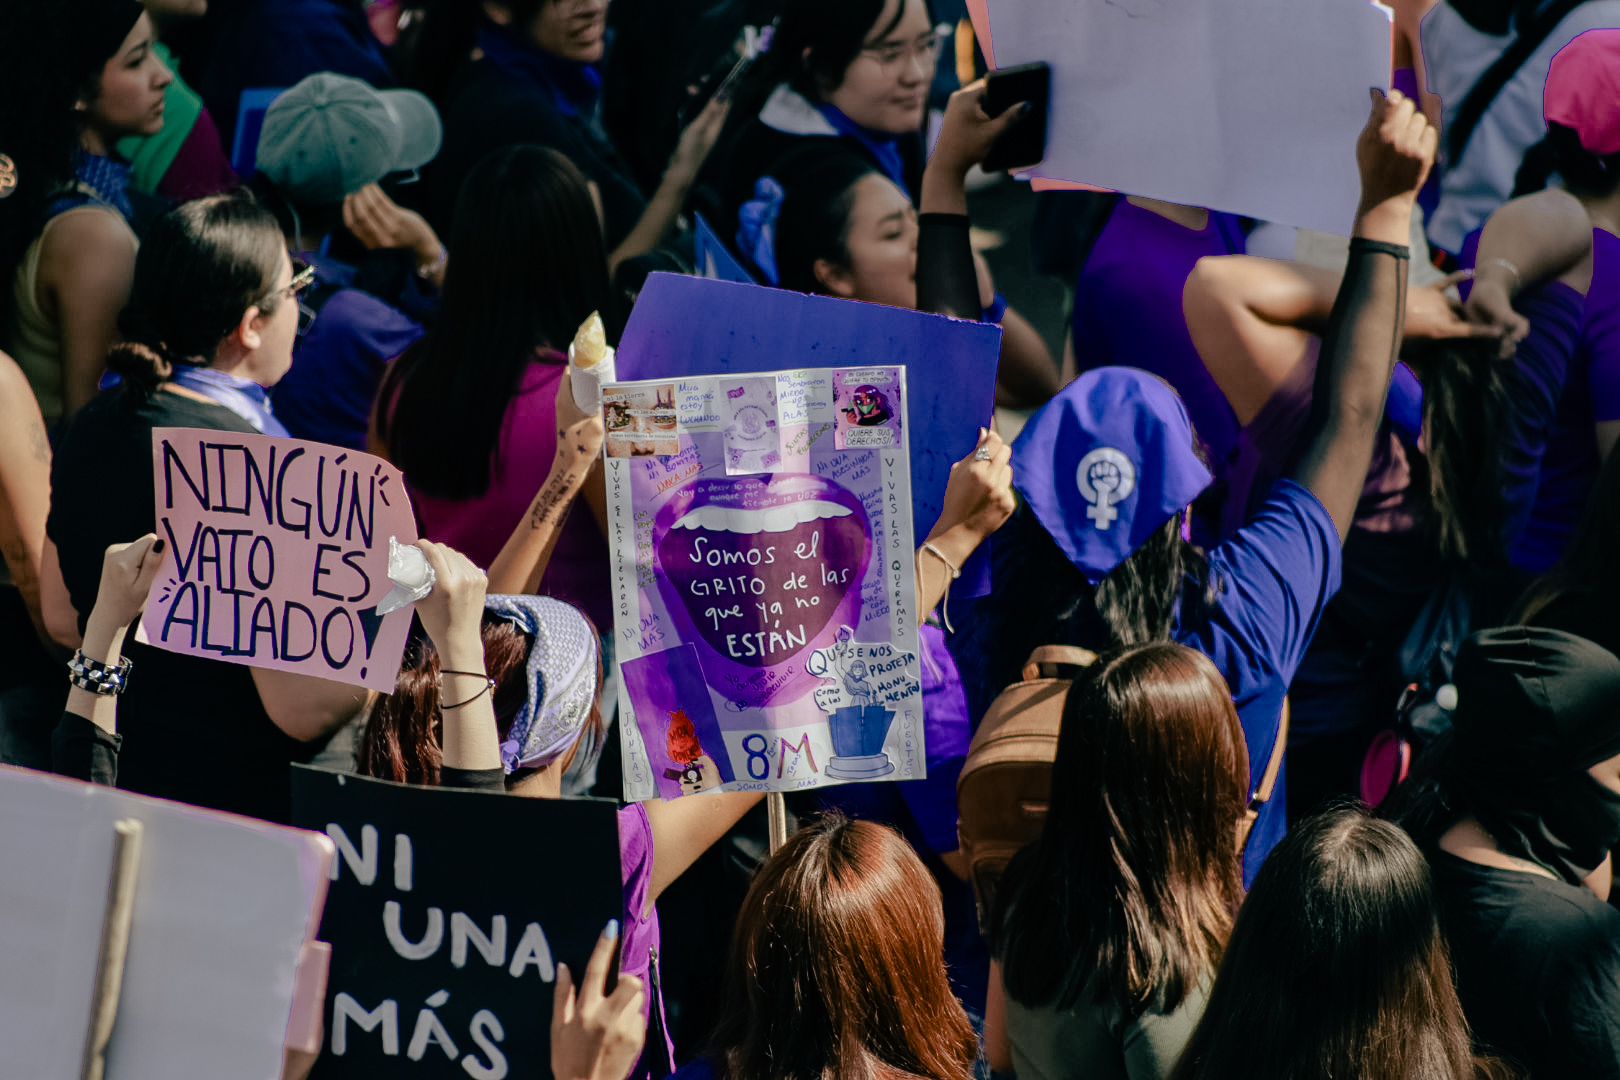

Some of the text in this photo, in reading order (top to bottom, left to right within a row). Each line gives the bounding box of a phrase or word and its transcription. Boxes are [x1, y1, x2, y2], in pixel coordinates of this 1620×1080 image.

[848, 428, 891, 437] QUIERE SUS
[162, 440, 375, 549] NINGÚN
[610, 460, 620, 498] VIVAS
[161, 517, 371, 603] VATO ES
[689, 531, 820, 567] Somos el
[886, 458, 907, 637] VIVAS LAS QUEREMOS
[690, 575, 766, 596] GRITO
[783, 572, 809, 590] de
[820, 563, 850, 586] las
[160, 581, 387, 680] ALIADO!
[705, 596, 821, 631] que ya no
[726, 619, 806, 658] ESTÁN
[847, 648, 863, 659] SE
[869, 645, 893, 658] NOS
[869, 652, 916, 678] PROTEJA
[624, 711, 643, 783] JUNTAS
[742, 732, 819, 780] 8M
[904, 709, 913, 776] FUERTES
[326, 823, 413, 892] NI
[383, 901, 555, 983] UNA
[331, 990, 509, 1080] MÁS
